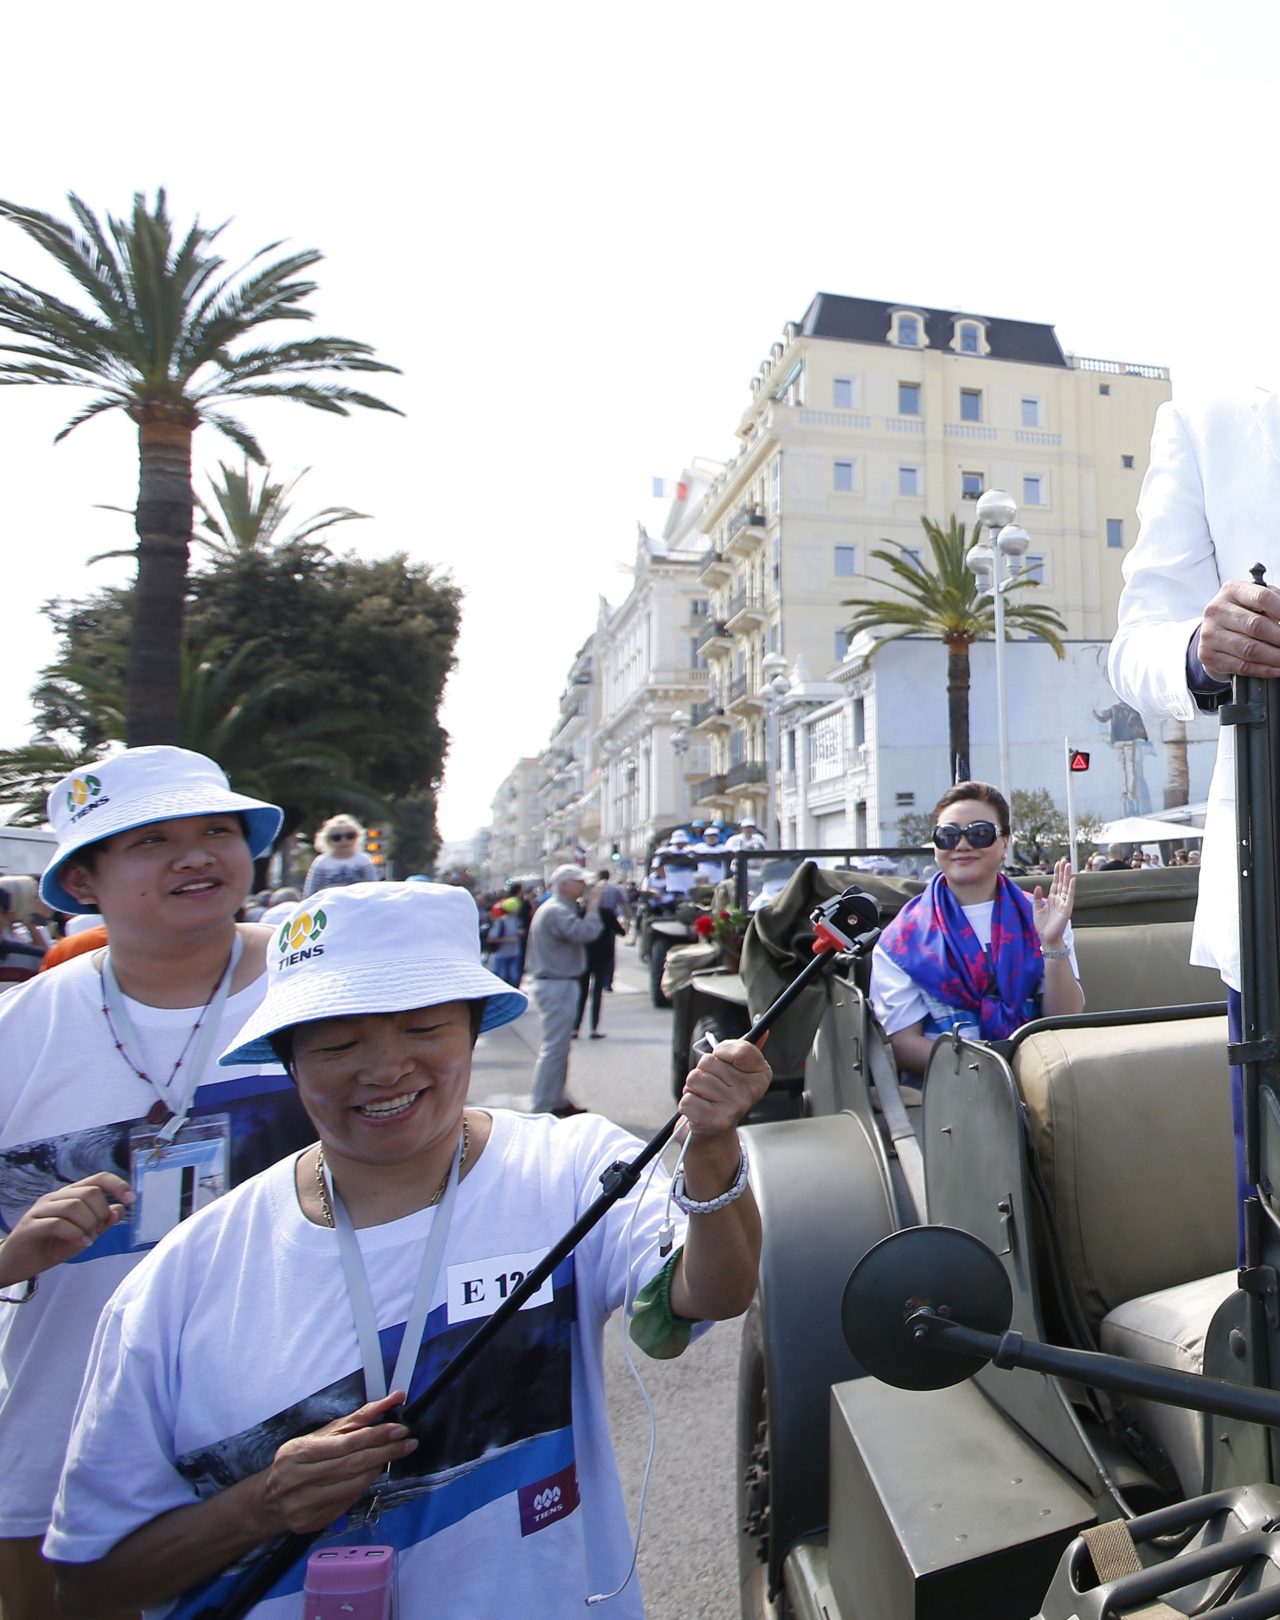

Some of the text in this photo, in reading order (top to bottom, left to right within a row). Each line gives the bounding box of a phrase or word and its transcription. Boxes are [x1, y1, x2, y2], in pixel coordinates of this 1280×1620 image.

[71, 795, 110, 824] TIENS
[279, 944, 325, 971] TIENS
[461, 1269, 542, 1306] E 12
[534, 1503, 563, 1522] TIENS
